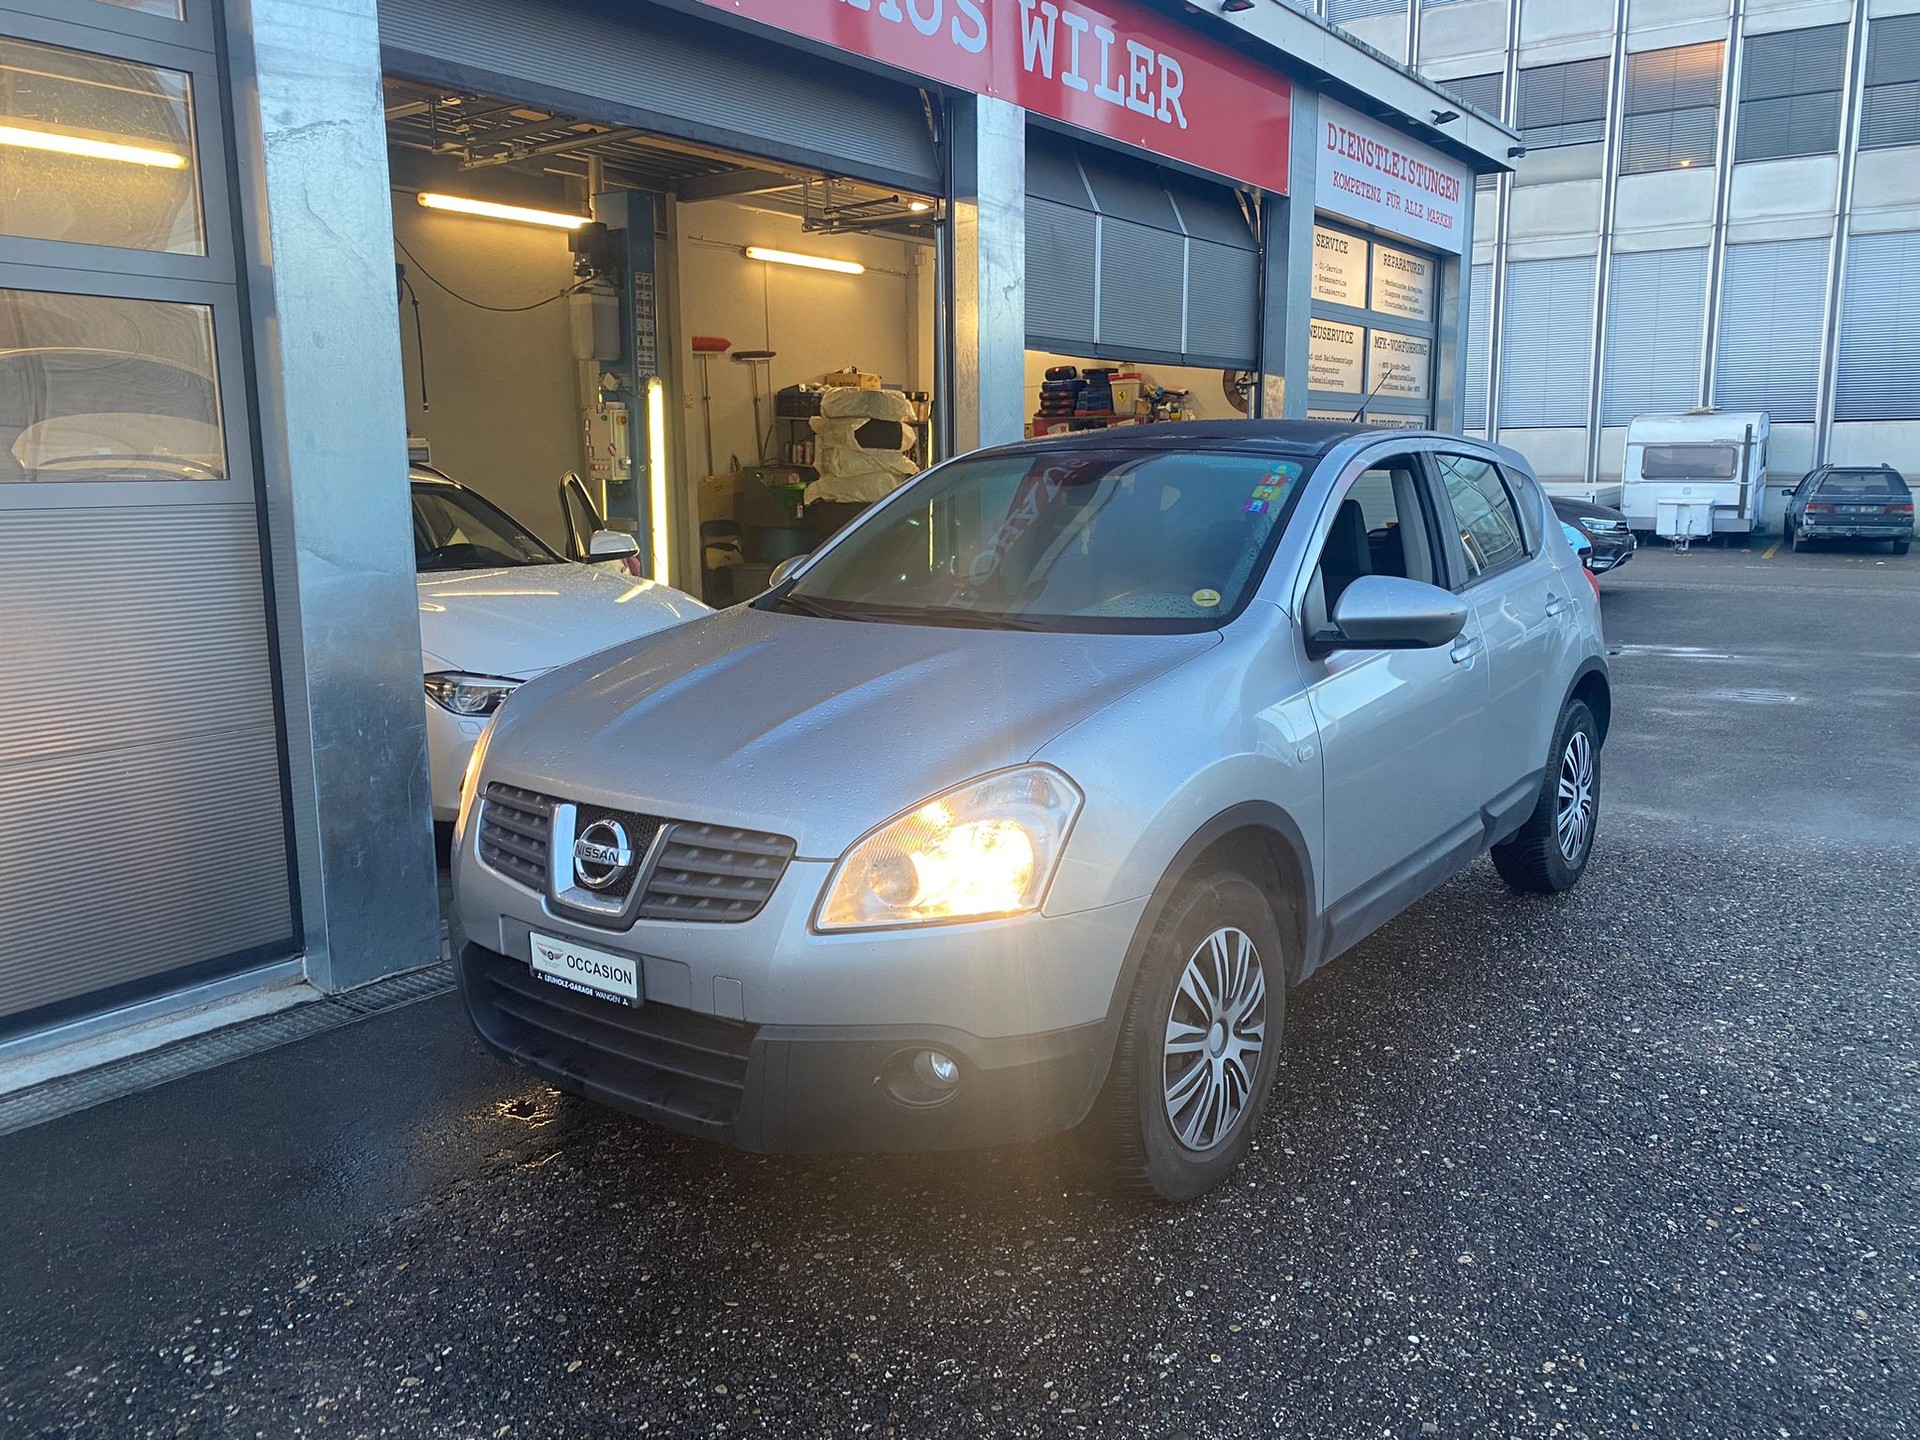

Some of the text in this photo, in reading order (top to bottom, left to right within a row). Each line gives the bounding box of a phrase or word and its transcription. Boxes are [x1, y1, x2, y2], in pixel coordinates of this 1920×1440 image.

[1018, 0, 1188, 130] WILER
[1327, 122, 1459, 203] DIENSTLEISTUNGEN
[1333, 170, 1453, 229] KOMPETENZ FÜR ALLE MARKEN
[1315, 233, 1349, 254] SERVICE
[1383, 254, 1425, 277] REPARATUREN
[576, 844, 619, 862] NISSAN
[566, 955, 632, 985] OCCASION
[594, 990, 620, 1003] WANGEN
